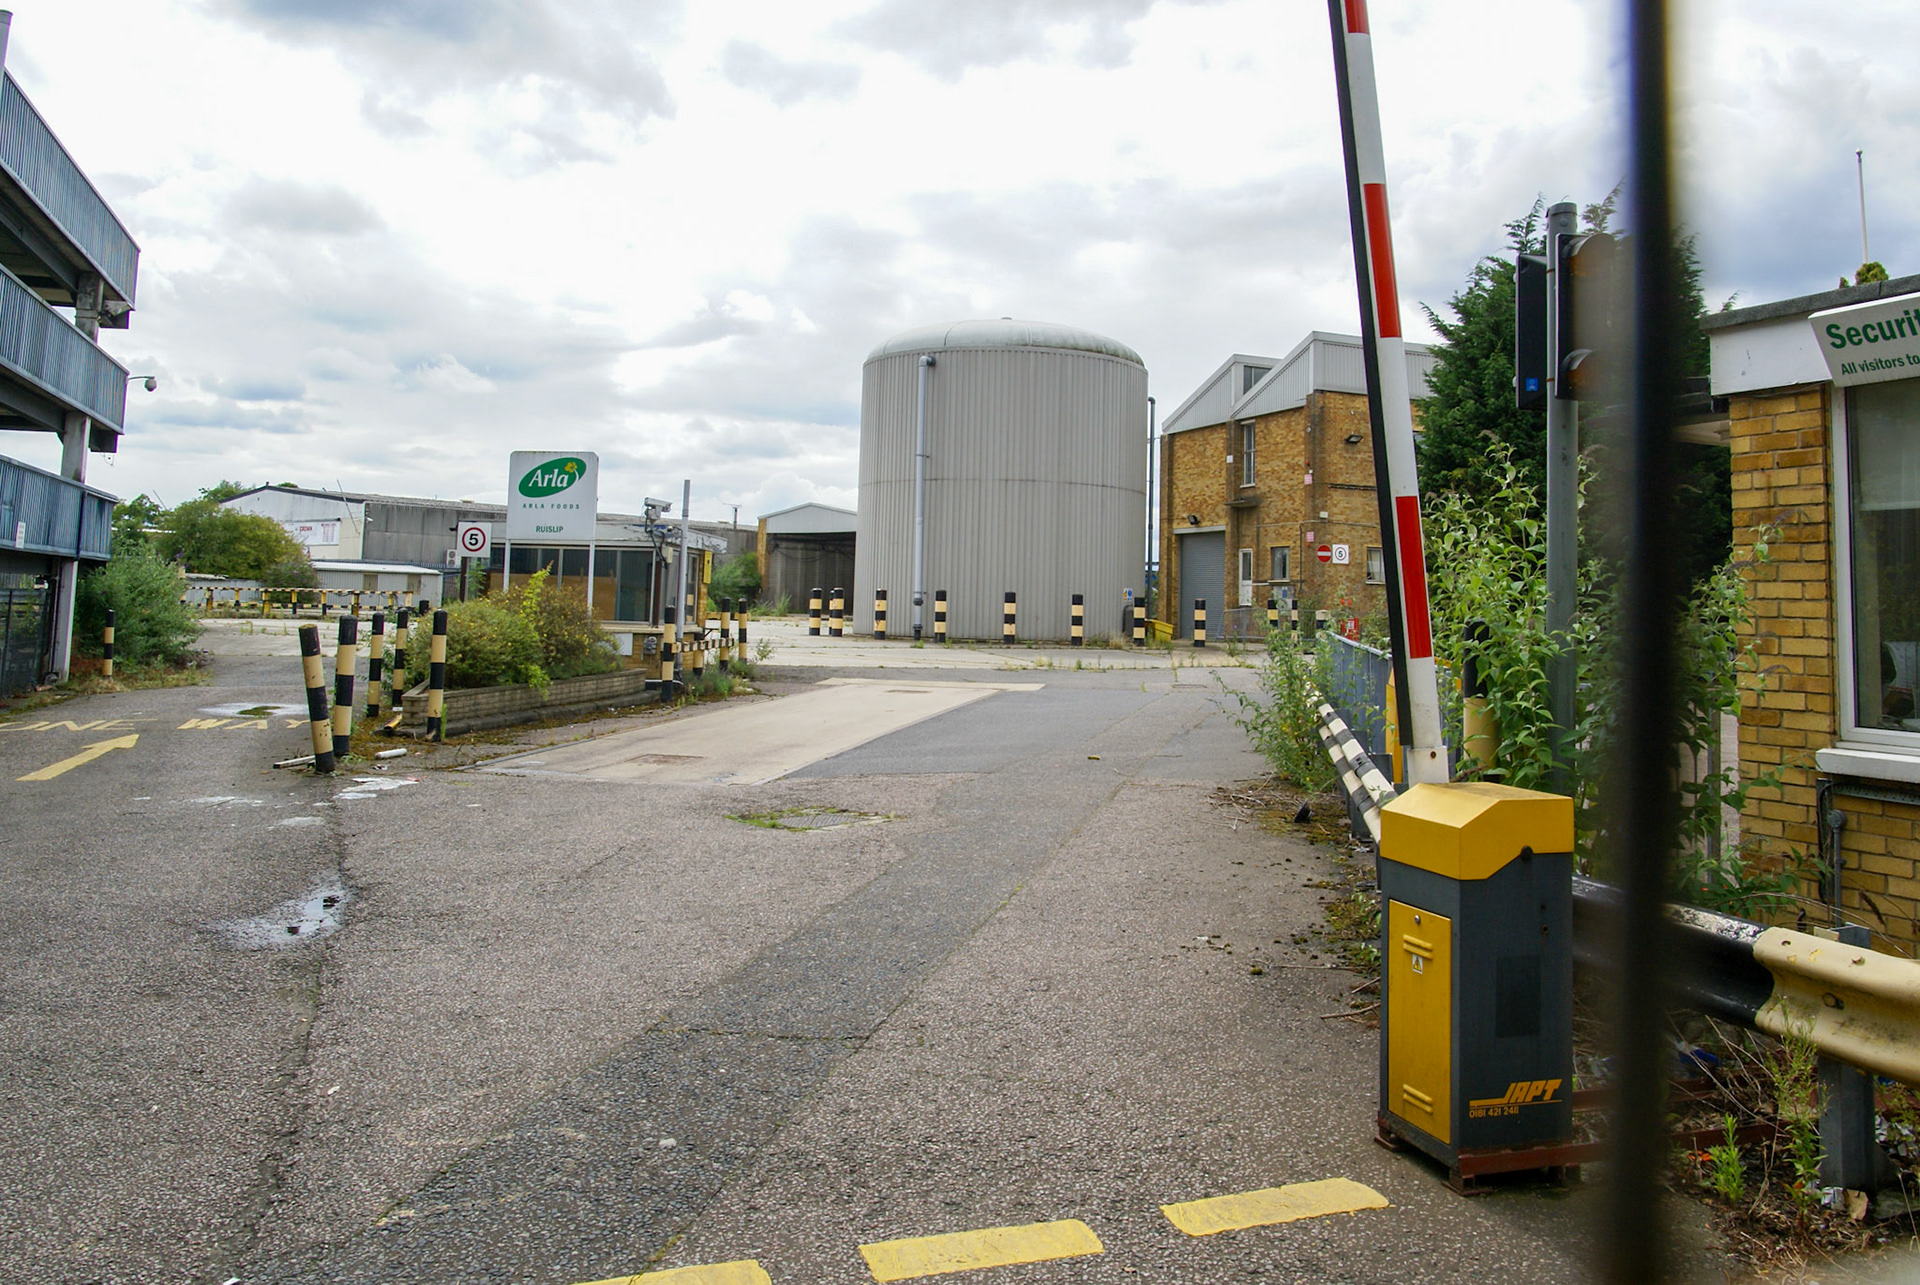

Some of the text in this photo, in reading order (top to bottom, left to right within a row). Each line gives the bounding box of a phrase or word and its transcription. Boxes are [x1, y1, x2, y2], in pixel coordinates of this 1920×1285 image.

[1841, 353, 1920, 375] All visitors to
[528, 468, 569, 487] Arla
[535, 525, 564, 533] RUISLIP
[469, 533, 478, 546] 5
[1338, 550, 1343, 558] 5
[0, 718, 310, 732] ONE WAY
[1488, 1107, 1501, 1117] 421
